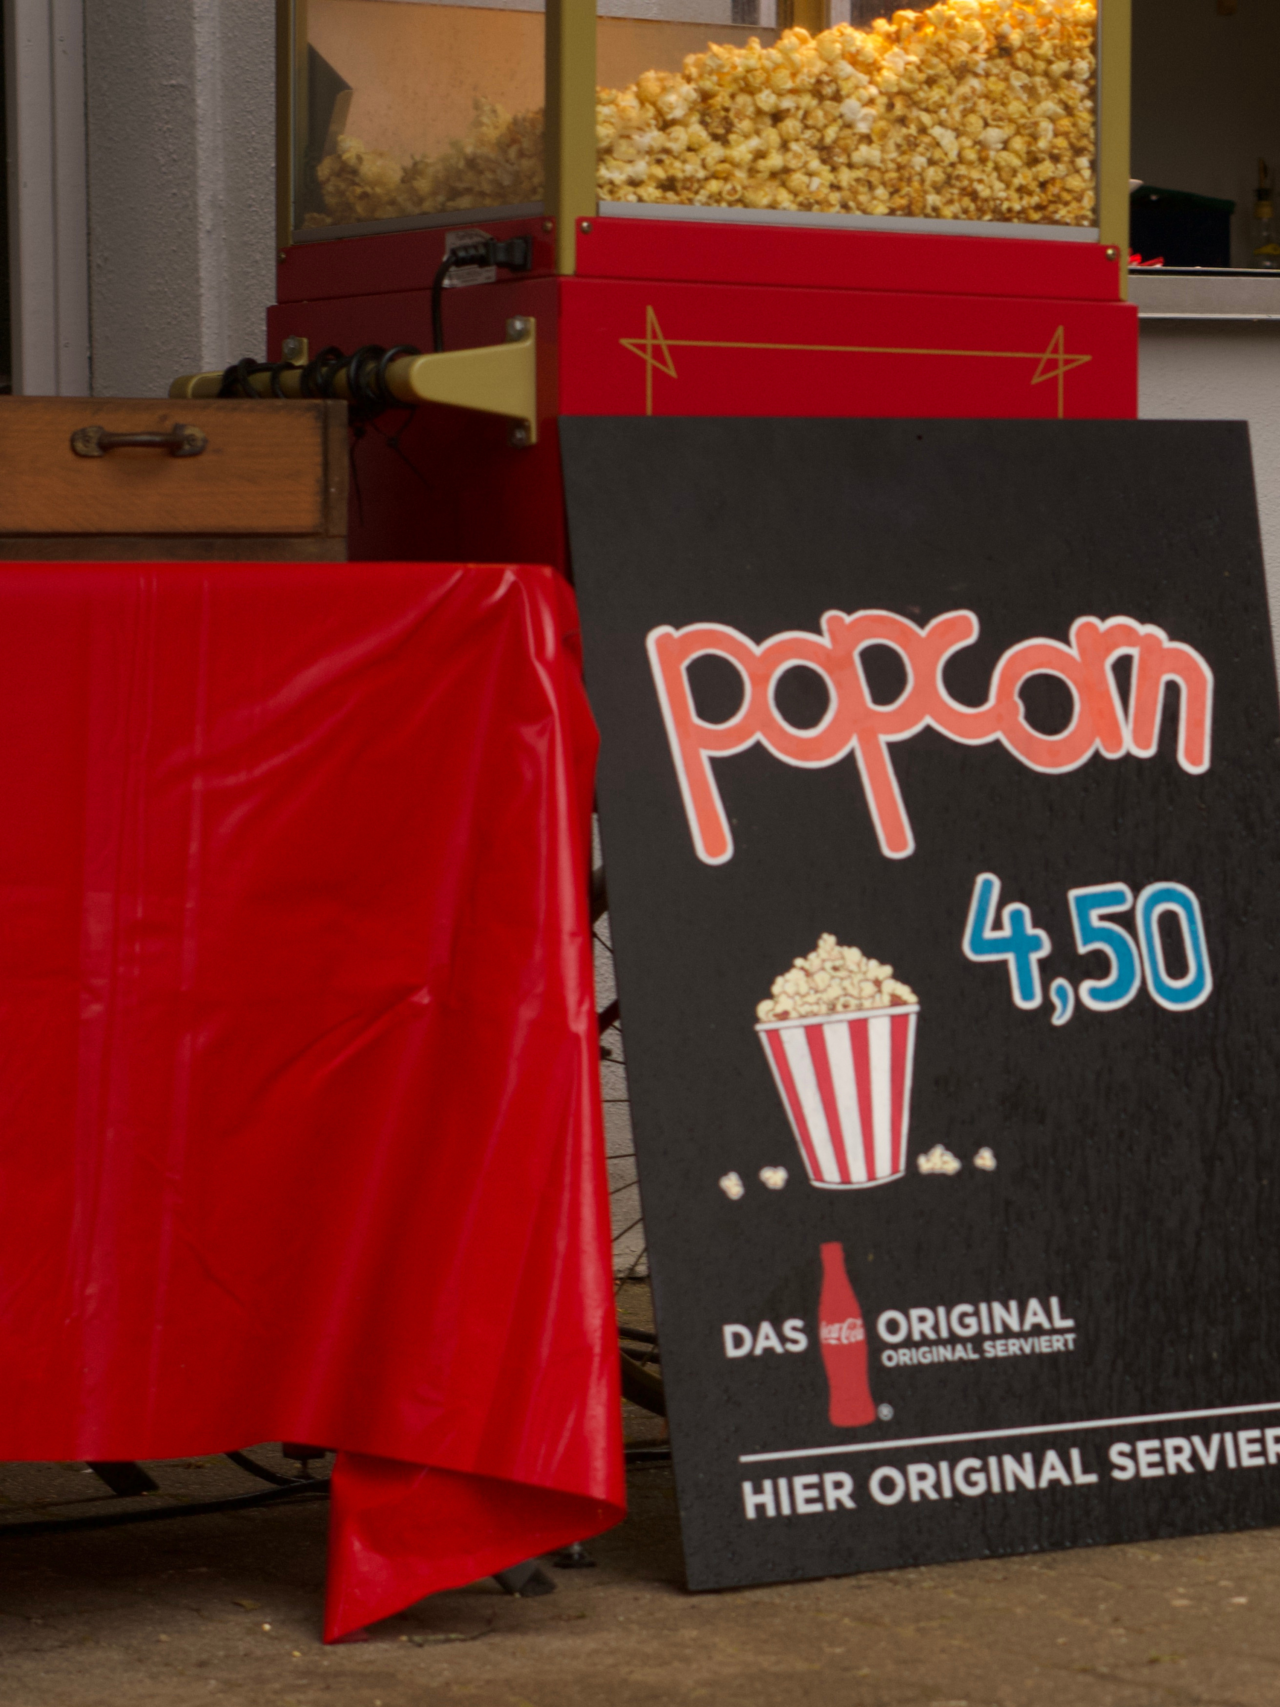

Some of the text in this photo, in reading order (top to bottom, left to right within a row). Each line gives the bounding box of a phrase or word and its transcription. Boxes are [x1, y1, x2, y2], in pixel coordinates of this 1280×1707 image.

[646, 609, 1214, 866] popcorn
[962, 872, 1213, 1026] 4,50
[722, 1296, 1076, 1358] DAS ORIGINAL
[881, 1333, 1077, 1368] ORIGINAL SERVIERT
[742, 1471, 857, 1520] HIER
[868, 1447, 1099, 1506] ORIGINAL
